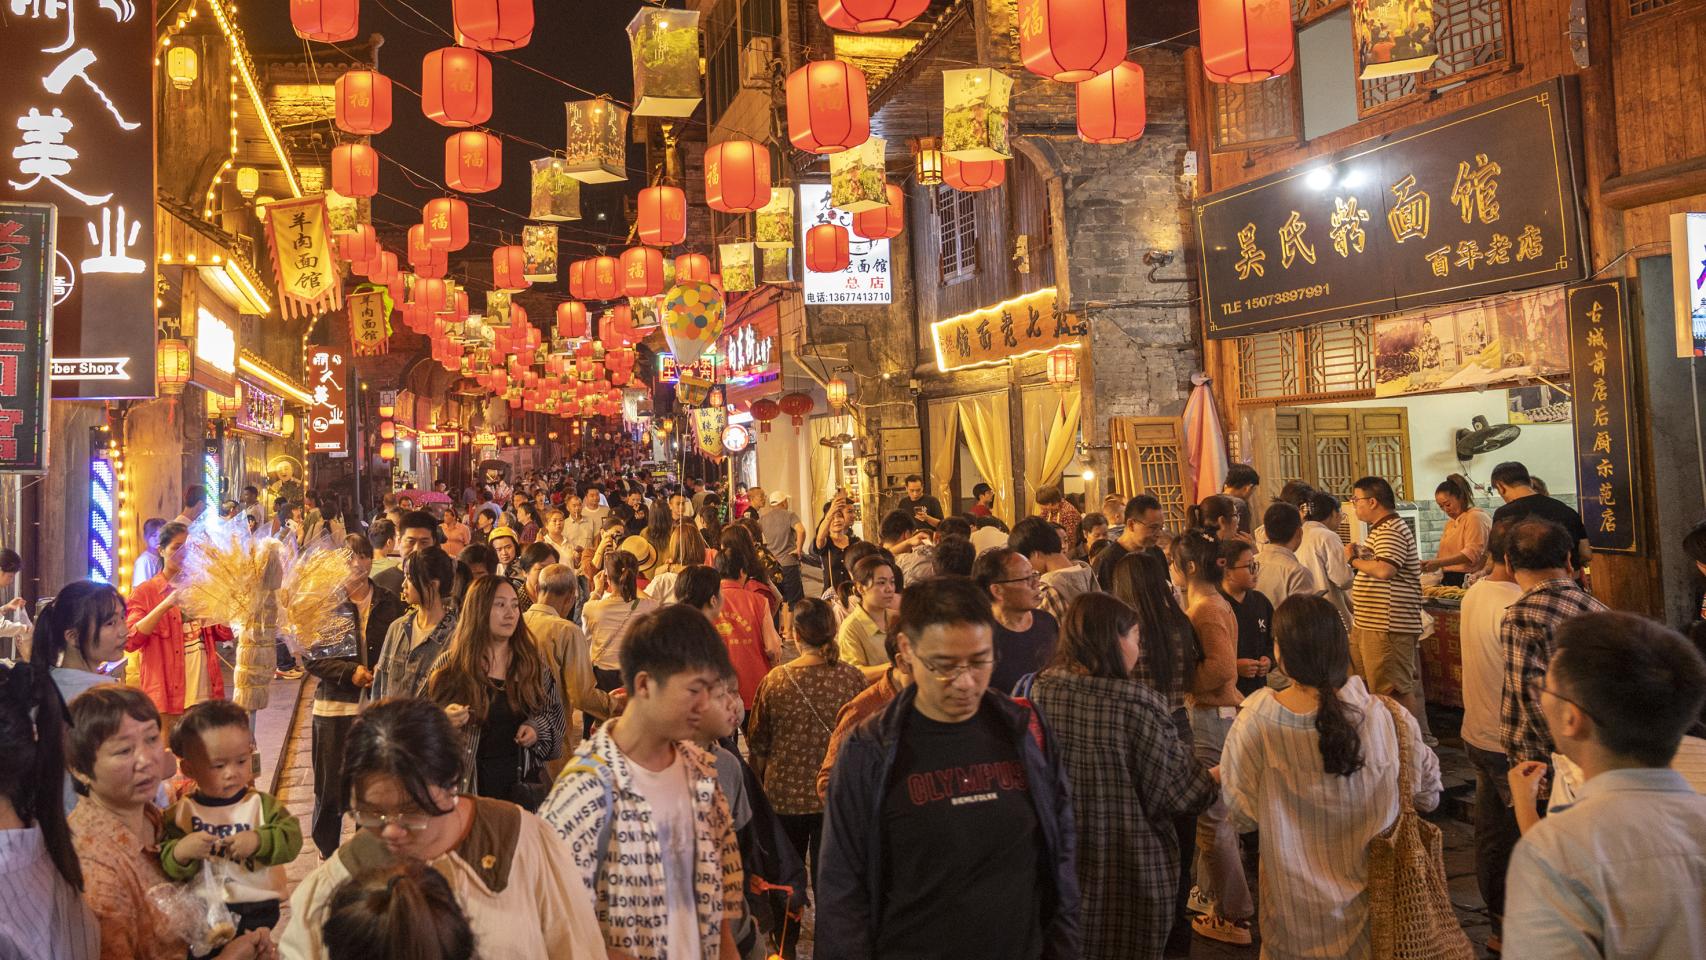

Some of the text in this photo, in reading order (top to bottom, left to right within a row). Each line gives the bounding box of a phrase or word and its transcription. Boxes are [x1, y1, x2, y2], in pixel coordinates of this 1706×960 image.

[431, 212, 448, 230] 福
[288, 212, 322, 290] 羊肉面馆
[1426, 224, 1544, 278] 百年老店
[628, 261, 645, 279] 福
[79, 361, 114, 376] Shop
